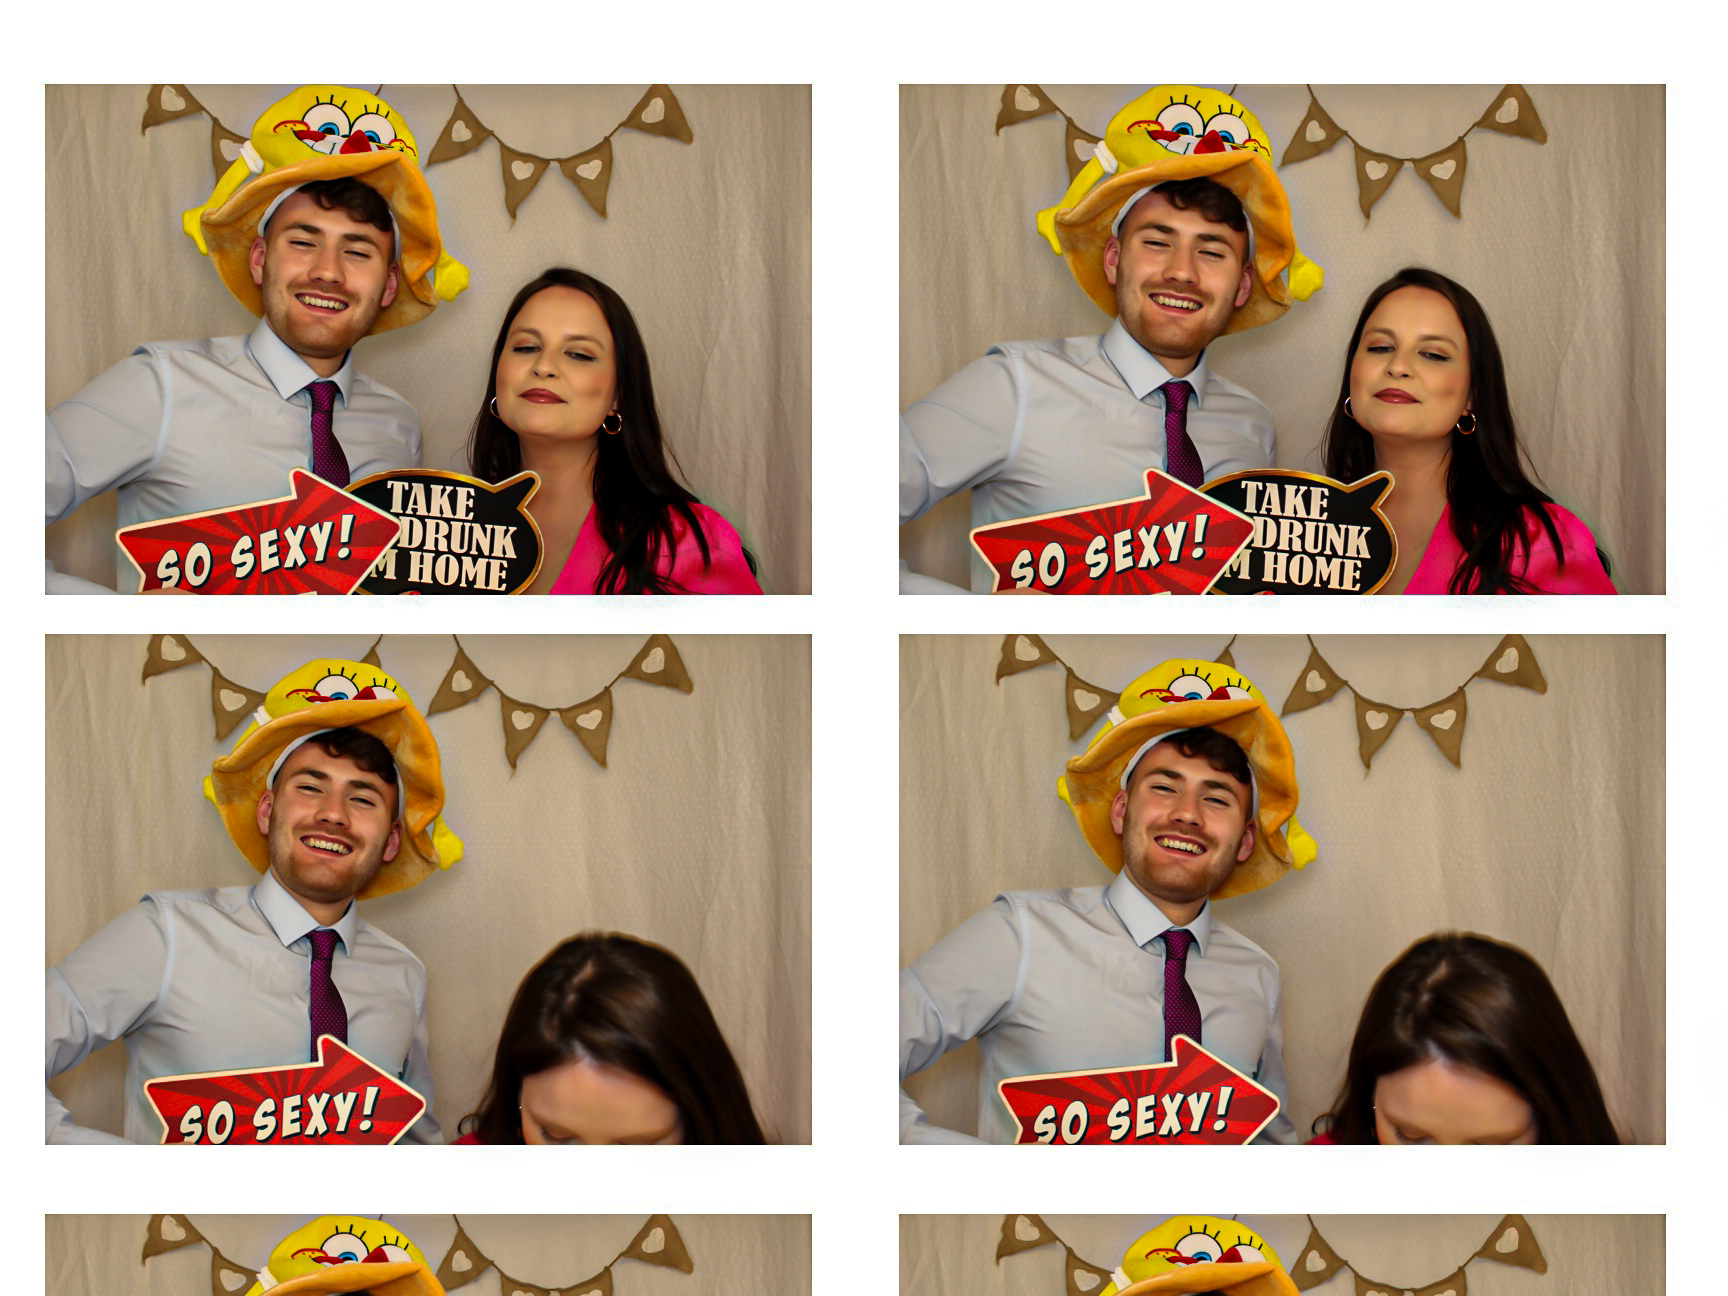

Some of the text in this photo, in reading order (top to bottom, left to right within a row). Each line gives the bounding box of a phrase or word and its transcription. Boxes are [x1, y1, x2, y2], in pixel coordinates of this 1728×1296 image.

[387, 480, 475, 521] TAKE
[1241, 480, 1329, 521] TAKE
[156, 514, 355, 588] SO SEXY!
[397, 515, 518, 559] DRUNK
[1010, 514, 1209, 588] SO SEXY!
[1251, 515, 1372, 559] DRUNK
[407, 550, 508, 592] HOME
[1261, 550, 1362, 592] HOME
[179, 1086, 380, 1144] SO SEXY!
[1033, 1086, 1234, 1144] SO SEXY!
